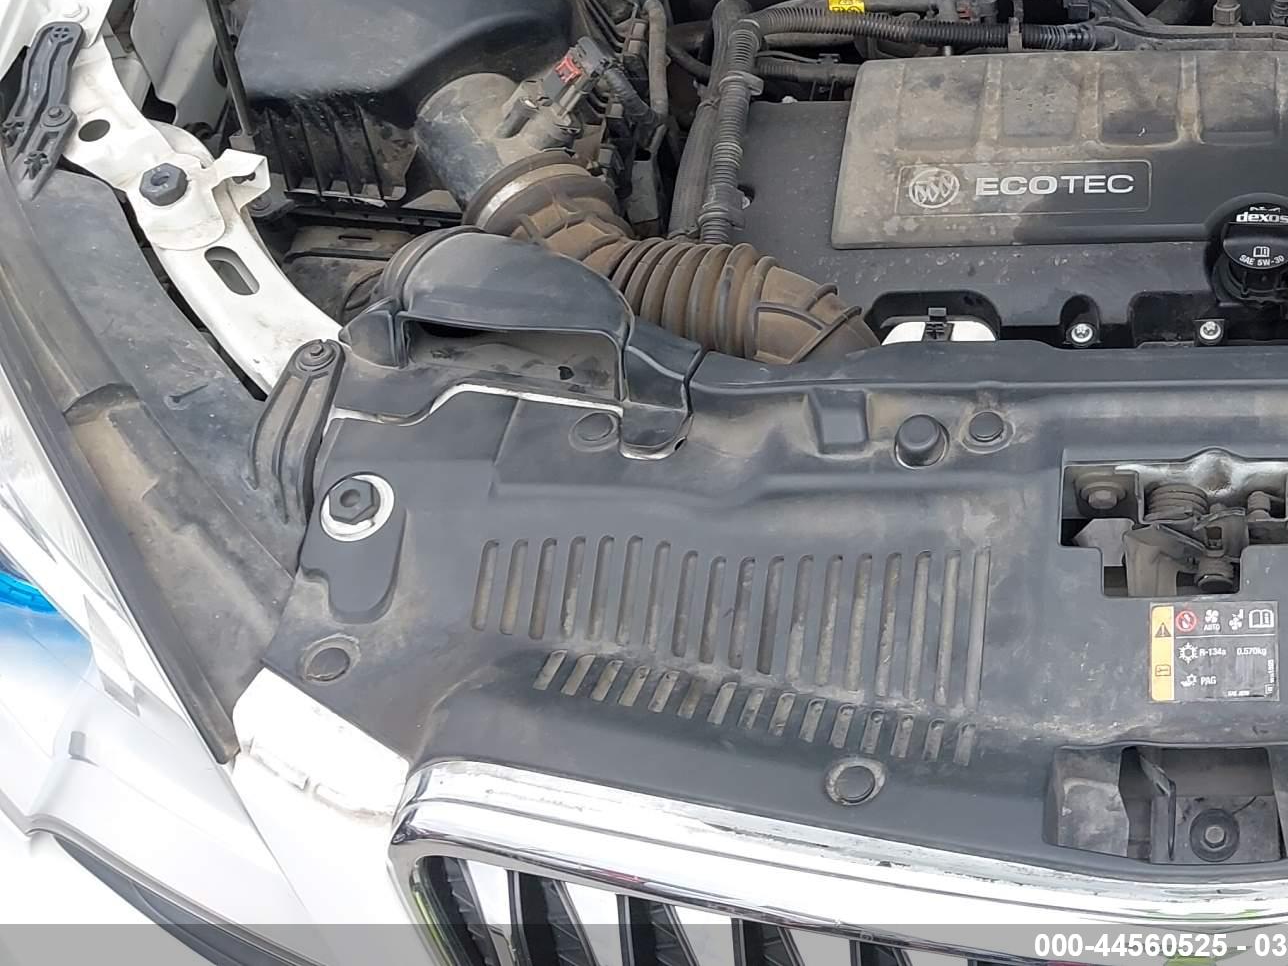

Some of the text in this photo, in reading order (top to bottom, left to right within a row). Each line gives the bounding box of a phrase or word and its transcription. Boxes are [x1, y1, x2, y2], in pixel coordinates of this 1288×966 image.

[976, 174, 1135, 196] ECOTEC
[1239, 254, 1285, 266] SAE 5W-30
[1203, 623, 1221, 631] AUTO
[1199, 647, 1226, 656] R-134a
[1200, 676, 1217, 686] PAG
